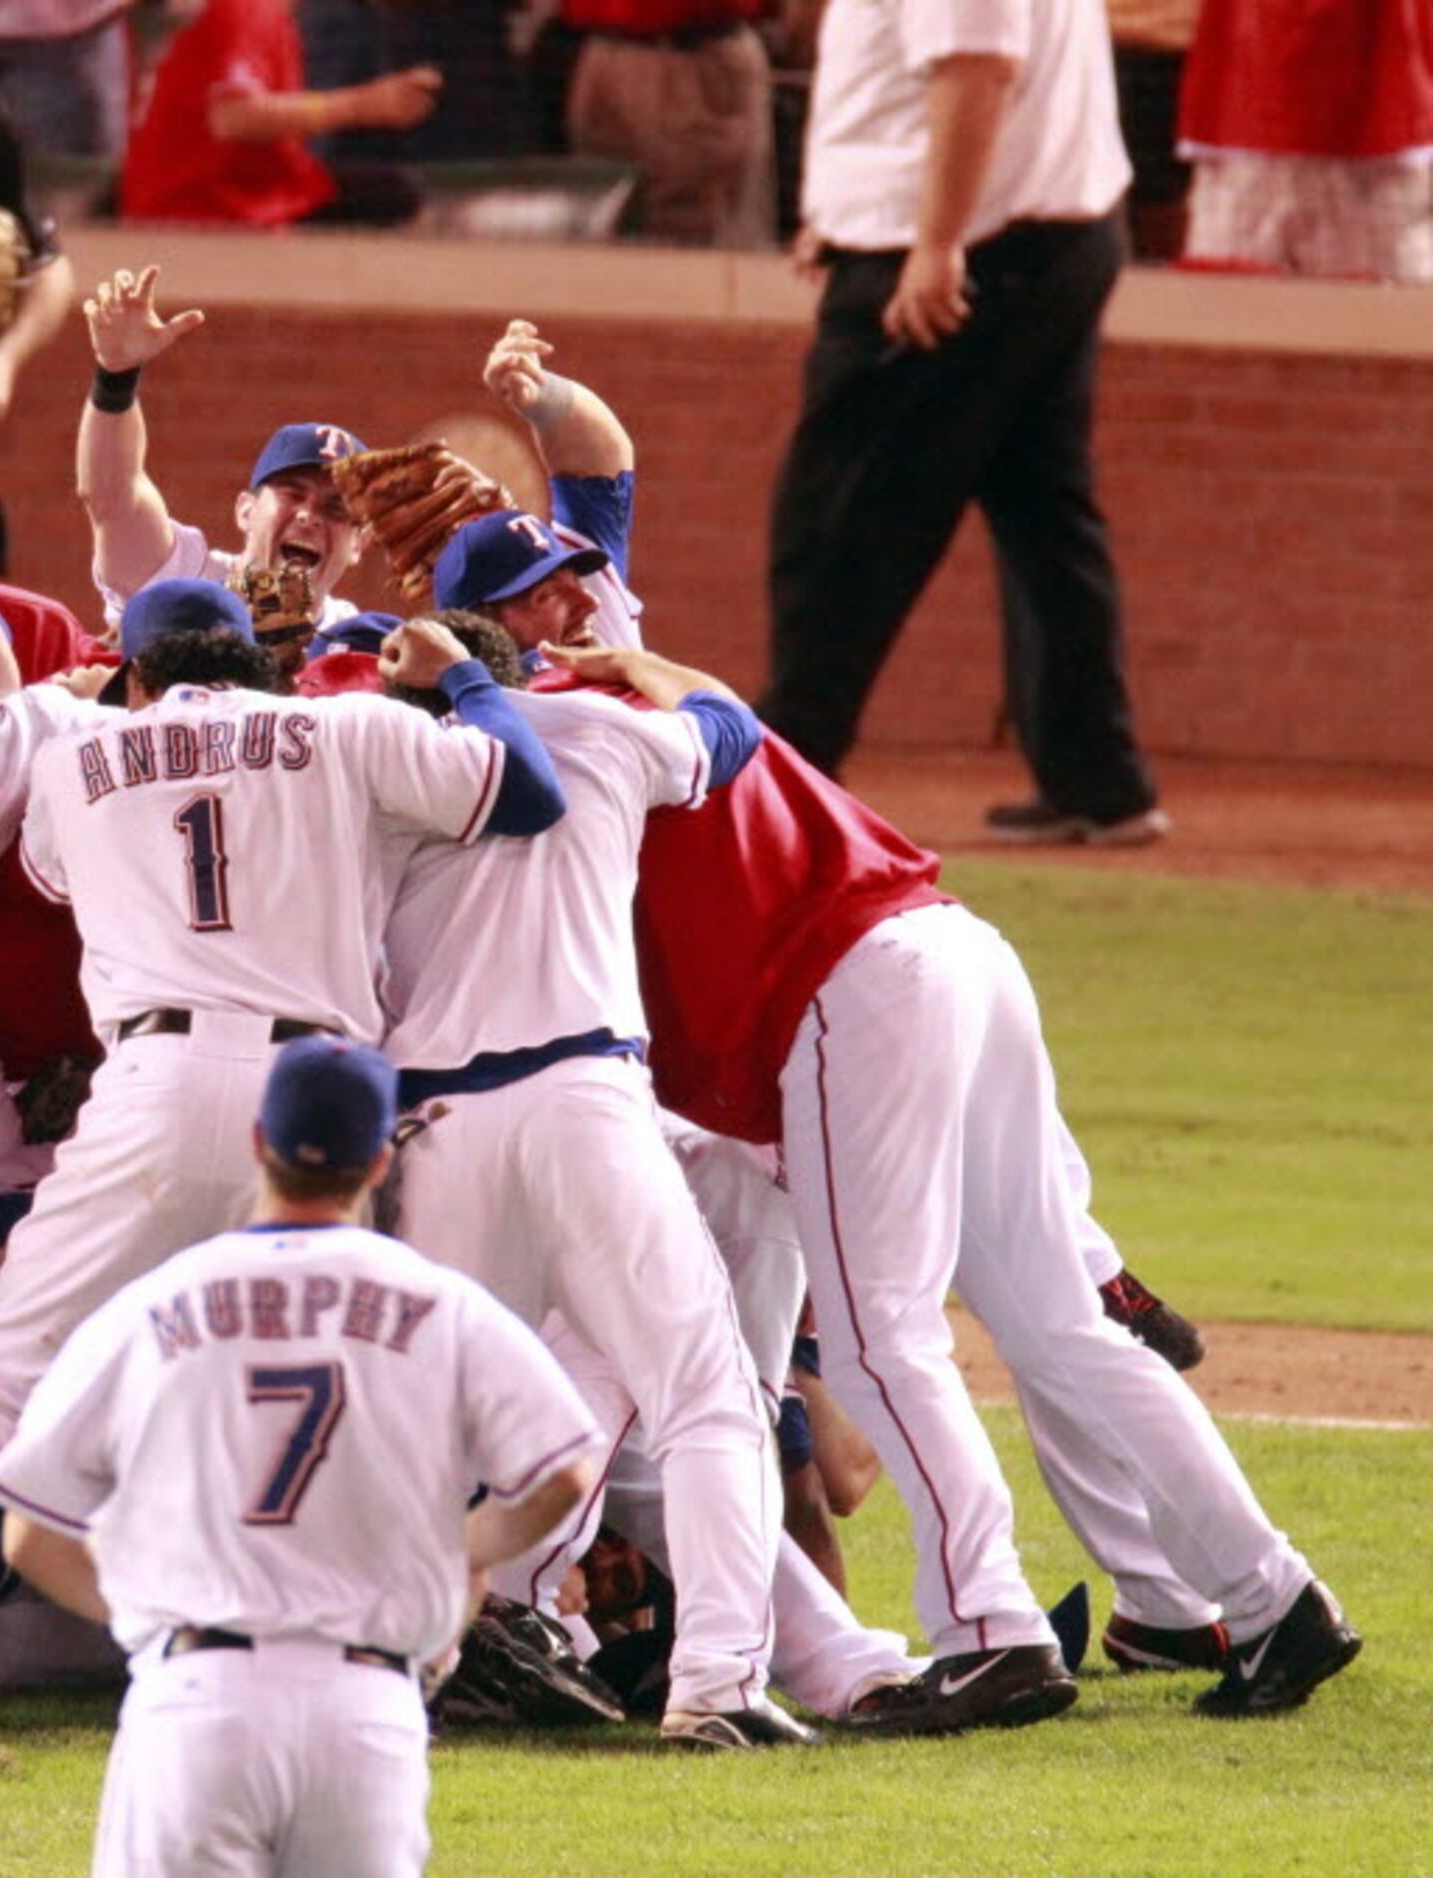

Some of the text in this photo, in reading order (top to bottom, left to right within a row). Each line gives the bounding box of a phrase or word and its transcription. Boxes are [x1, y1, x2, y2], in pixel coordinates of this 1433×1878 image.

[79, 711, 315, 805] ANDRUS
[173, 791, 233, 932] 1
[148, 1275, 437, 1362] MURPHY
[241, 1360, 347, 1526] 7
